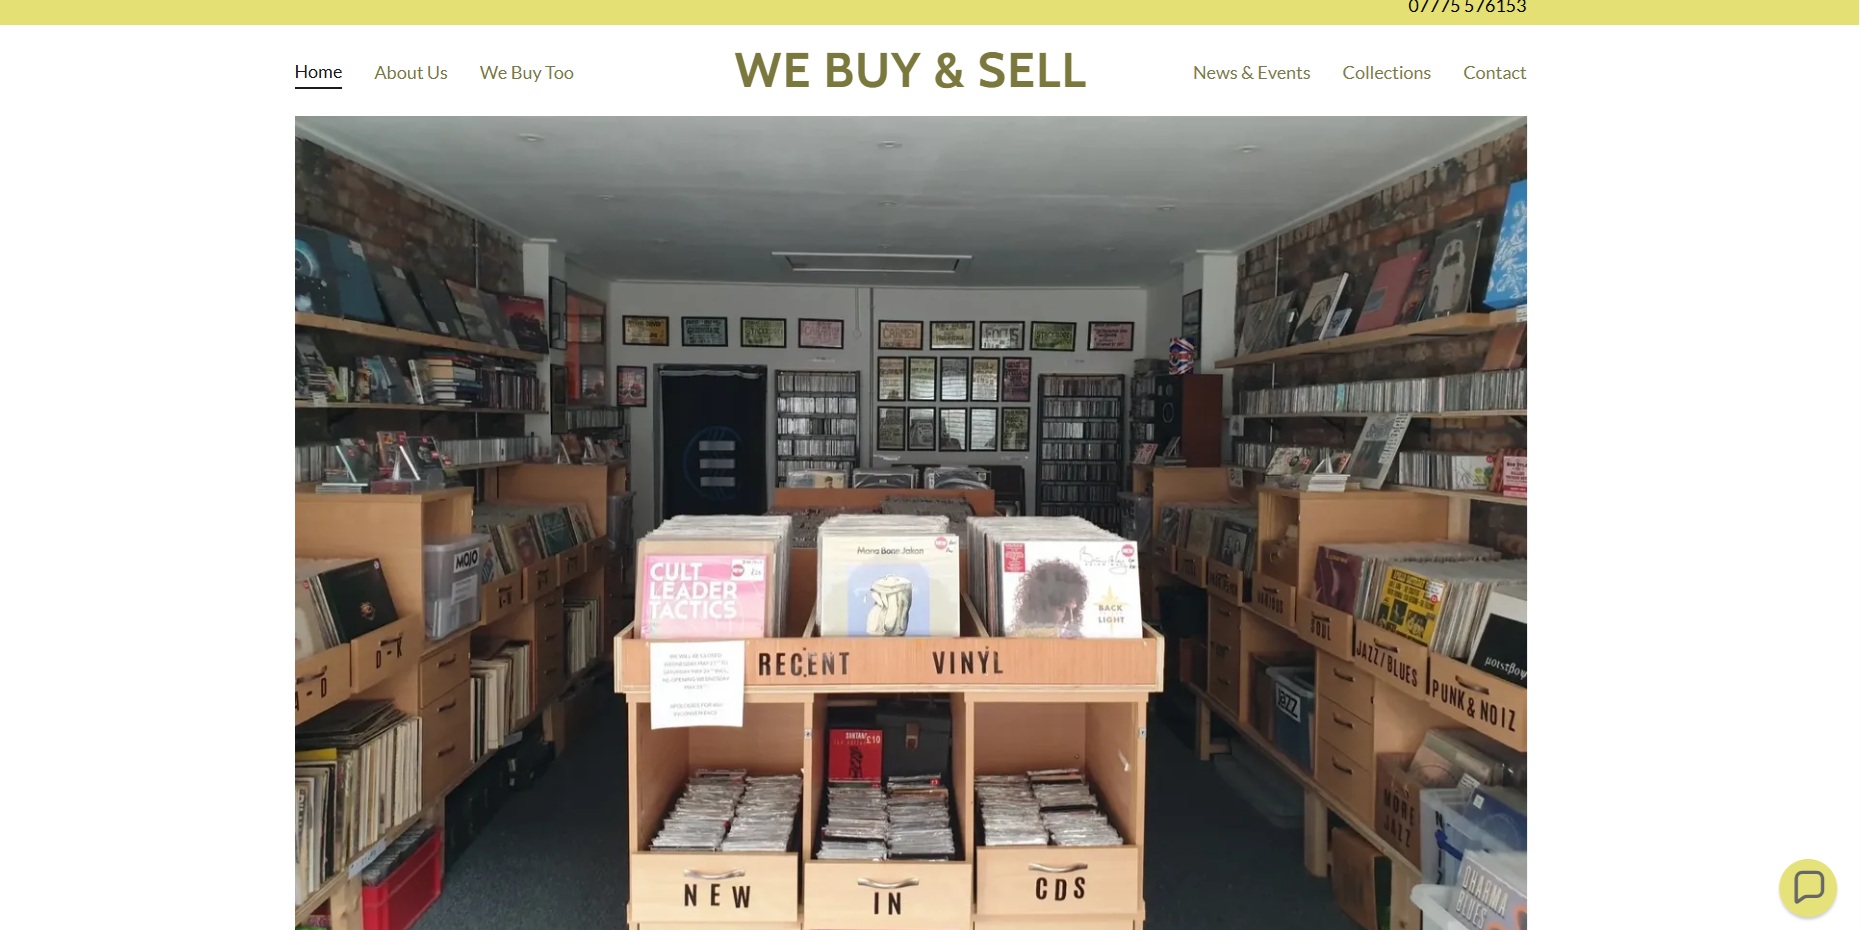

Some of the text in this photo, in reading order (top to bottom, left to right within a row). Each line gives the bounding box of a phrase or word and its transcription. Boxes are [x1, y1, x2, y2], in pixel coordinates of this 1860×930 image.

[456, 550, 478, 569] MOJO
[857, 546, 880, 556] Mona
[881, 546, 900, 556] Bone
[649, 562, 702, 581] CULT
[649, 581, 738, 600] LEADER
[649, 600, 738, 620] TACTICS
[1098, 604, 1123, 612] BACK
[1098, 616, 1125, 624] LIGHT
[1310, 617, 1332, 641] SOUL
[758, 650, 1004, 676] RECENT VINYL
[1432, 679, 1516, 732] PUNK & NOIZ
[866, 735, 881, 744] £10
[1384, 788, 1415, 826] MORE
[1384, 815, 1411, 848] JAZZ
[684, 884, 751, 908] NEW
[1036, 877, 1086, 901] CDS
[1462, 865, 1509, 917] DHARMA
[874, 892, 902, 915] IN
[1456, 890, 1488, 929] BLUES
